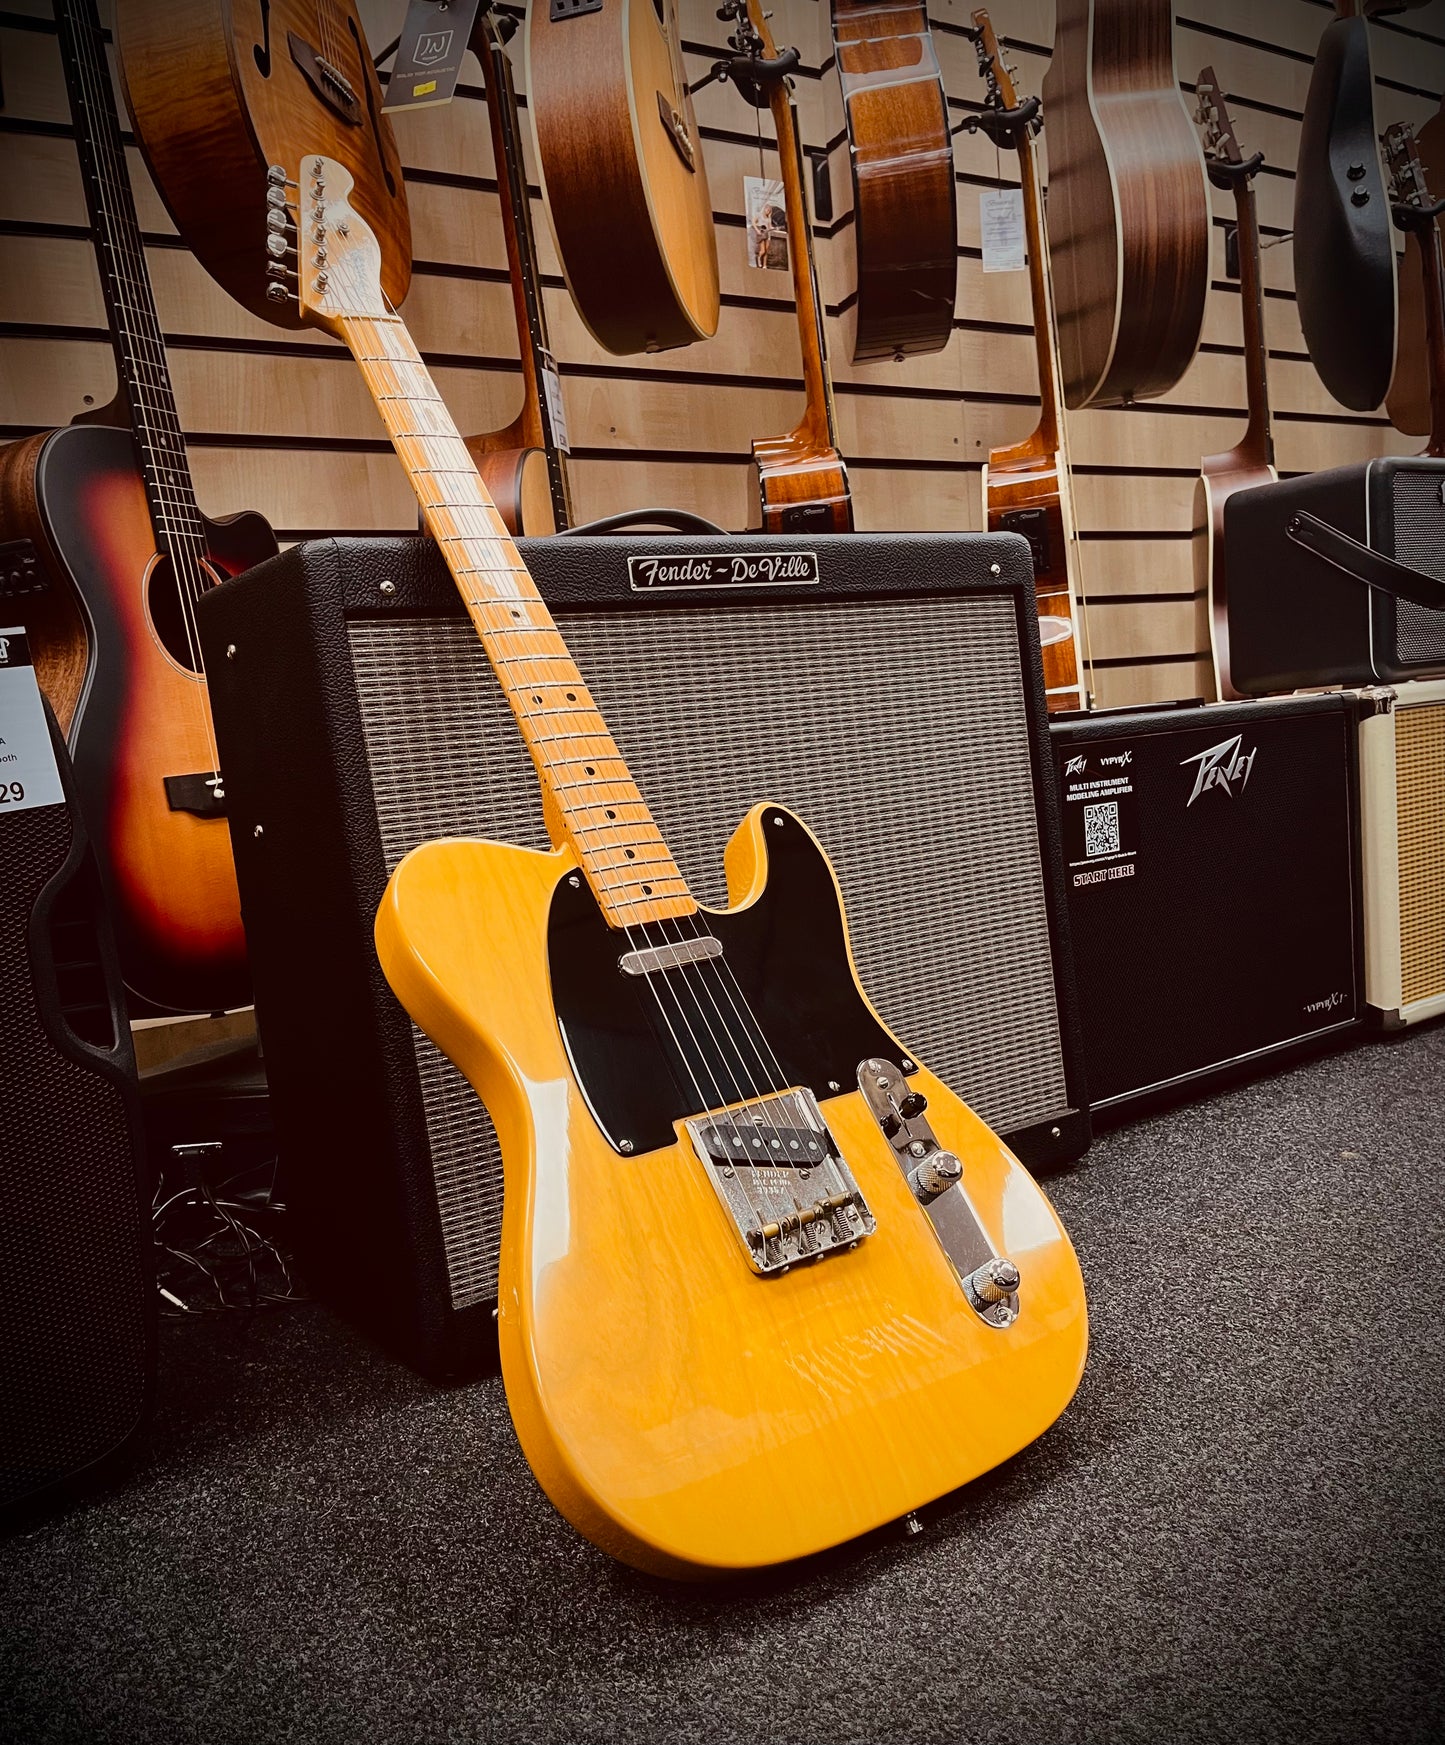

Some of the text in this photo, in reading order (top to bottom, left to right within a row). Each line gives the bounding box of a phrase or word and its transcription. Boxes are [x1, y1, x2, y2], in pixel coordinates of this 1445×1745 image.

[638, 558, 713, 586] Fender
[1066, 785, 1133, 802] MODELING AMPLIFIER
[1069, 777, 1129, 792] MULTI INSTRUMENT
[1073, 863, 1135, 887] START HERE
